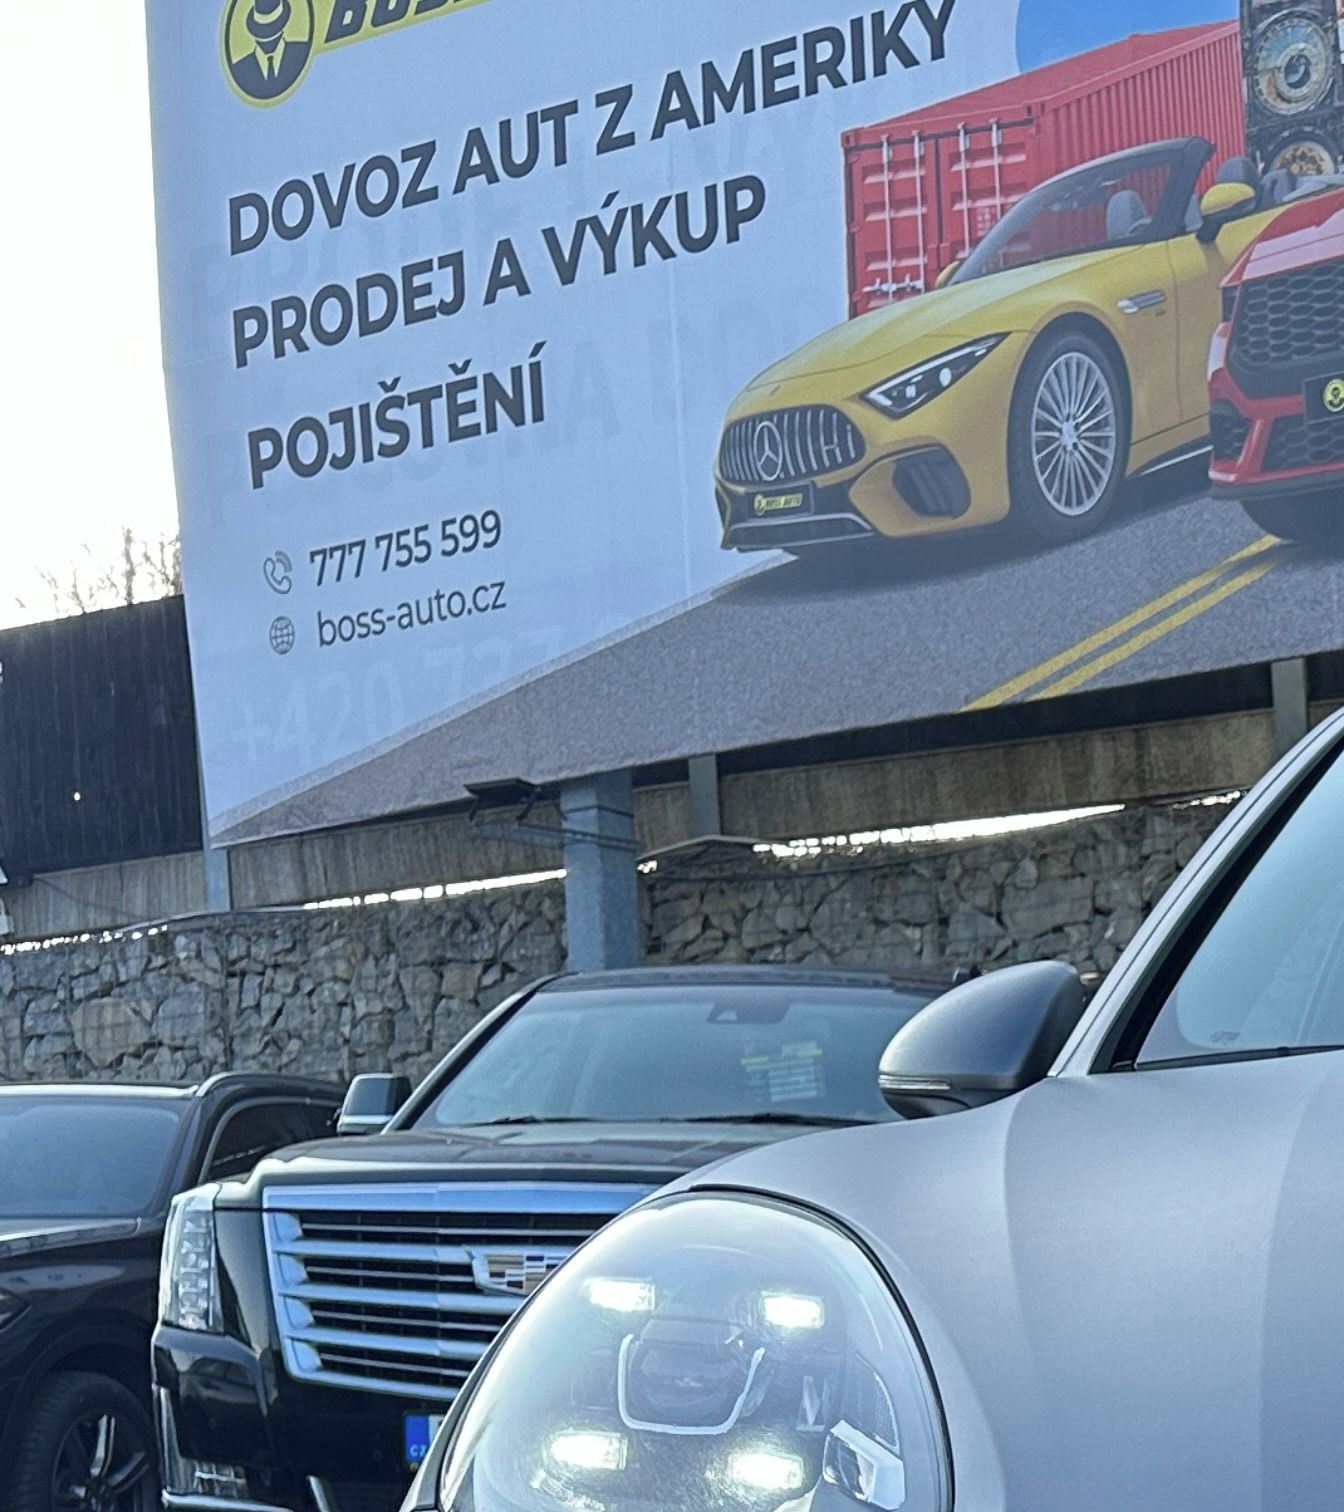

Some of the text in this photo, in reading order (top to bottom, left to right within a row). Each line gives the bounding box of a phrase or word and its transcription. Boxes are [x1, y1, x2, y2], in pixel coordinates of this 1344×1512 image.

[229, 0, 955, 255] DOVOZ AUT Z AMERIKY
[232, 175, 767, 369] PRODEJ A VÝKUP
[248, 340, 547, 490] POJIŠTĚNÍ
[309, 509, 502, 586] 777 755 599
[317, 581, 507, 647] boss-auto.cz
